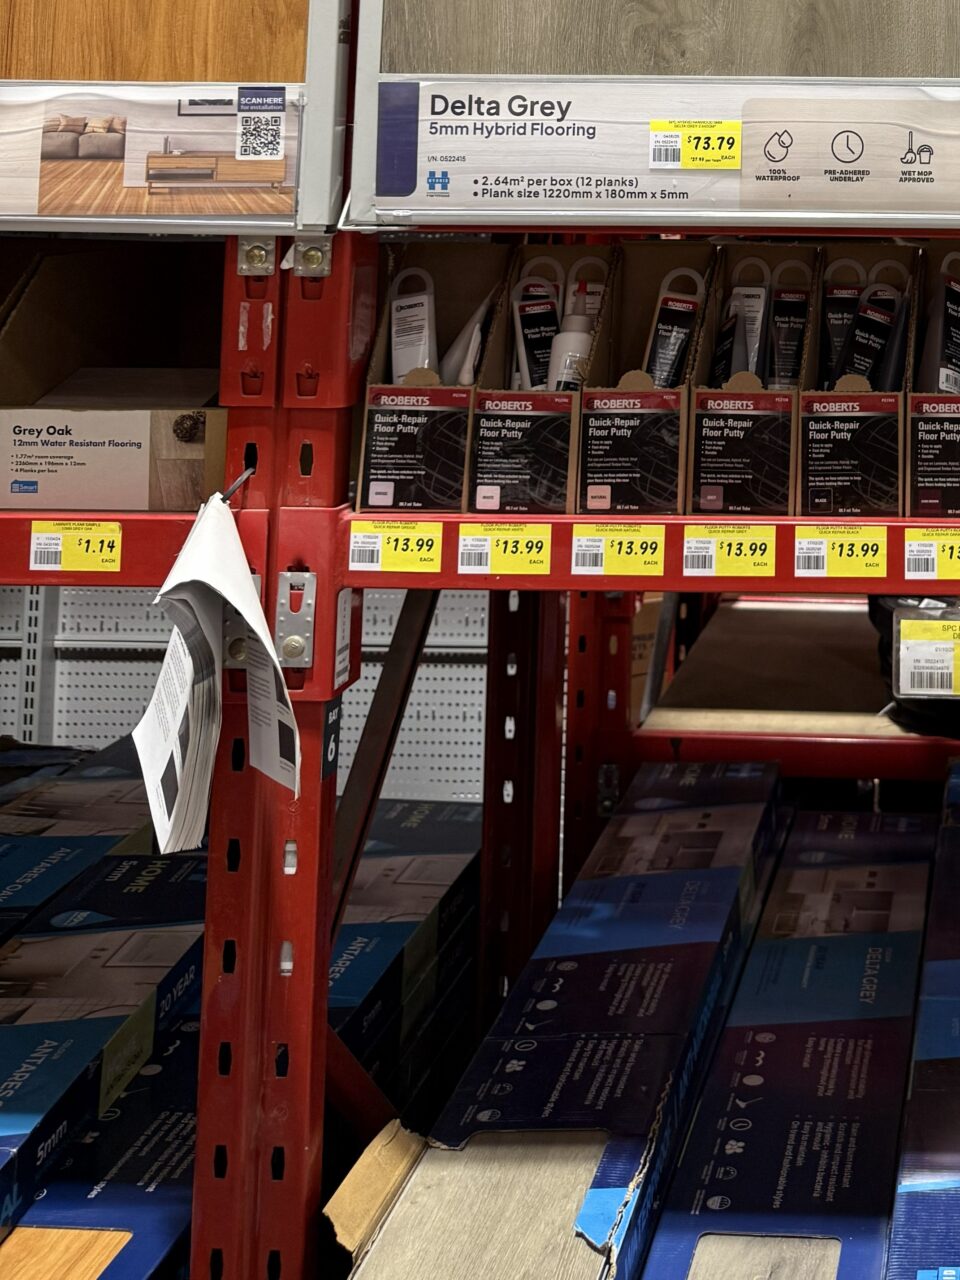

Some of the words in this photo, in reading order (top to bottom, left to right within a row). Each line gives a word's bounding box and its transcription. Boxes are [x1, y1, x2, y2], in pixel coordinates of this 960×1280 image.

[430, 94, 500, 117] Delta
[508, 95, 572, 121] Grey
[429, 122, 468, 136] 5mm
[473, 122, 526, 139] Hybrid
[531, 122, 596, 139] Flooring
[688, 136, 735, 151] $73.79
[527, 178, 544, 189] per
[547, 176, 572, 187] box
[575, 176, 593, 188] (12
[595, 176, 638, 189] planks)
[482, 189, 513, 199] Plank
[517, 189, 540, 199] size
[543, 189, 592, 199] 1220mm
[605, 189, 647, 200] 180mm
[650, 192, 657, 200] x
[660, 189, 688, 200] 5mm
[381, 395, 430, 406] ROBERTS
[485, 400, 532, 411] ROBERTS
[594, 398, 641, 409] ROBERTS
[707, 400, 753, 410] ROBERTS
[813, 402, 860, 412] ROBERTS
[375, 414, 428, 425] Quick-Repair
[809, 420, 859, 431] Quick-Repair
[13, 425, 43, 438] Grey
[46, 425, 72, 436] Oak
[374, 424, 394, 432] Floor
[397, 424, 419, 435] Putty
[809, 430, 829, 439] Floor
[831, 431, 851, 441] Putty
[41, 439, 66, 447] Water
[108, 440, 142, 449] Flooring
[78, 538, 115, 553] $1.14
[386, 537, 434, 552] $13.99
[495, 540, 543, 554] $13.99
[610, 540, 658, 556] $13.99
[719, 542, 768, 557] $13.99
[831, 542, 879, 557] $13.99
[328, 707, 338, 725] BAY
[327, 734, 336, 762] 6
[105, 859, 139, 883] 5mm
[123, 859, 171, 894] HOME
[0, 1039, 58, 1098] ANTARES
[35, 1120, 68, 1166] 5mm
